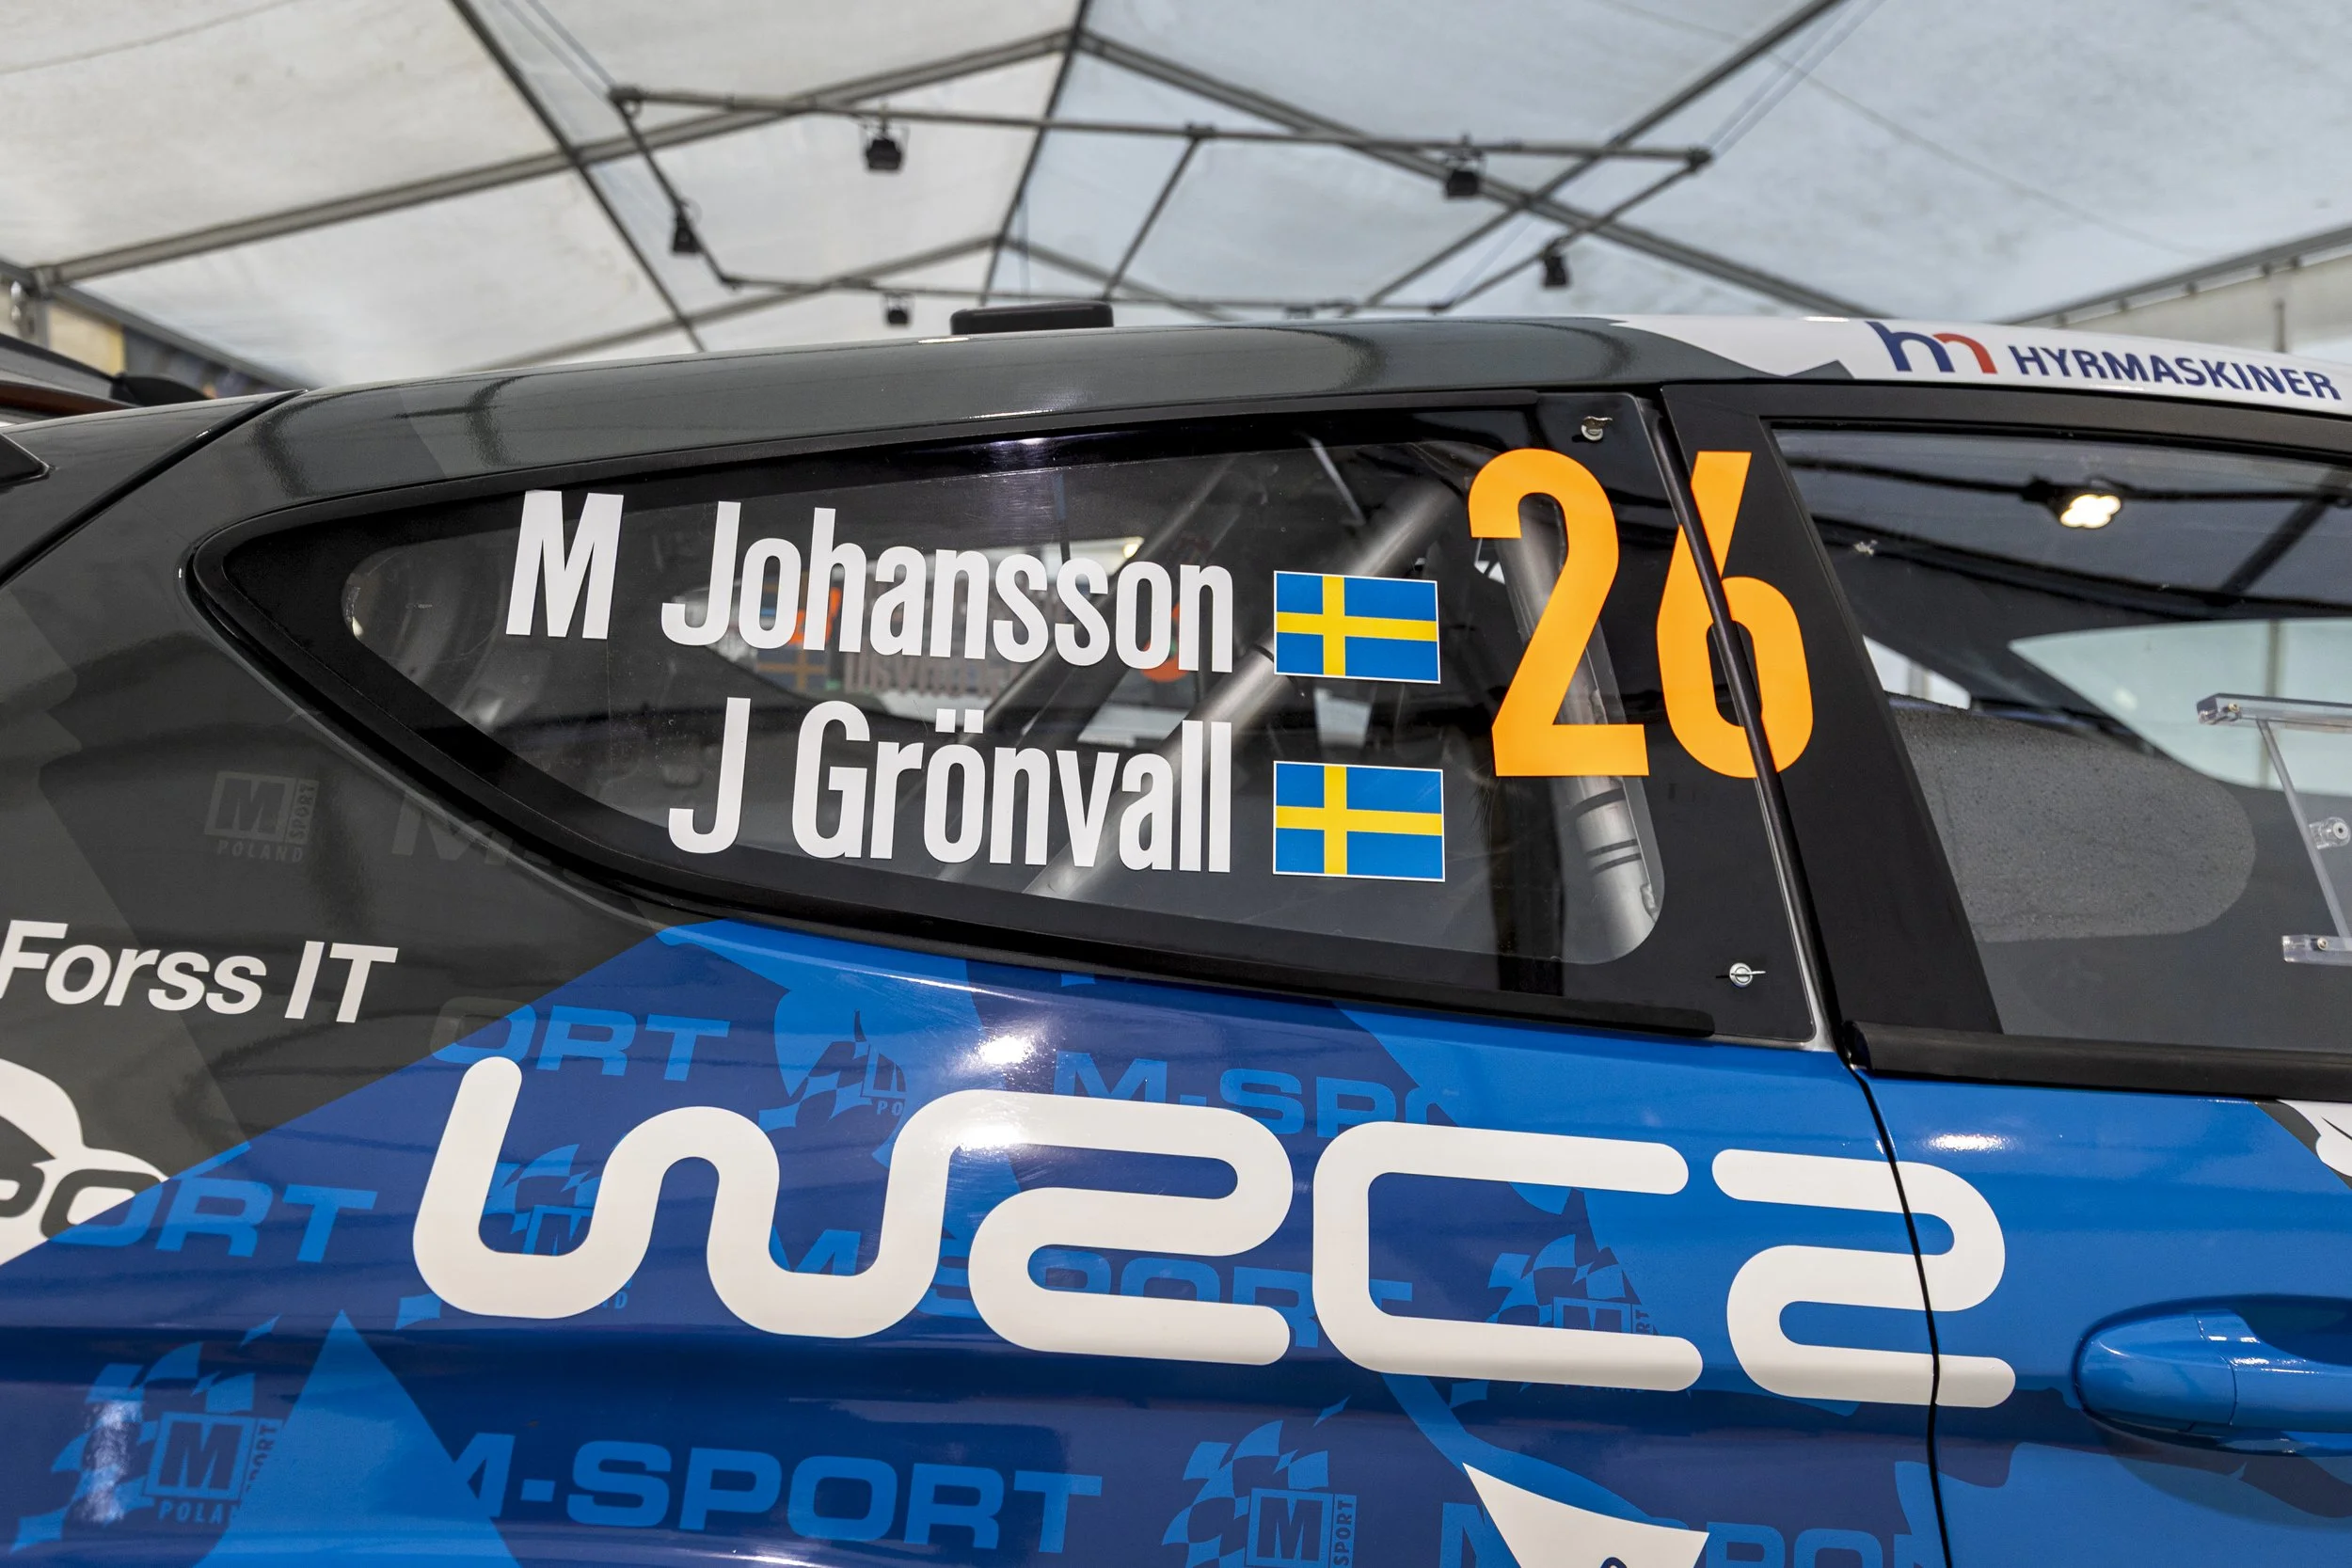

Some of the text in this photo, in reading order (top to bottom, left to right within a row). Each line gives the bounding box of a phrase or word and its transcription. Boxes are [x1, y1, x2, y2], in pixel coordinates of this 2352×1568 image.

[2009, 344, 2343, 402] HYRMASKINER
[506, 489, 1234, 673] M Johansson
[1468, 448, 1815, 779] 26
[668, 697, 752, 855] J
[791, 700, 1233, 874] Grönvall
[216, 839, 304, 864] POLAND
[0, 918, 399, 1023] Forss IT
[1333, 1499, 1353, 1567] SPORT
